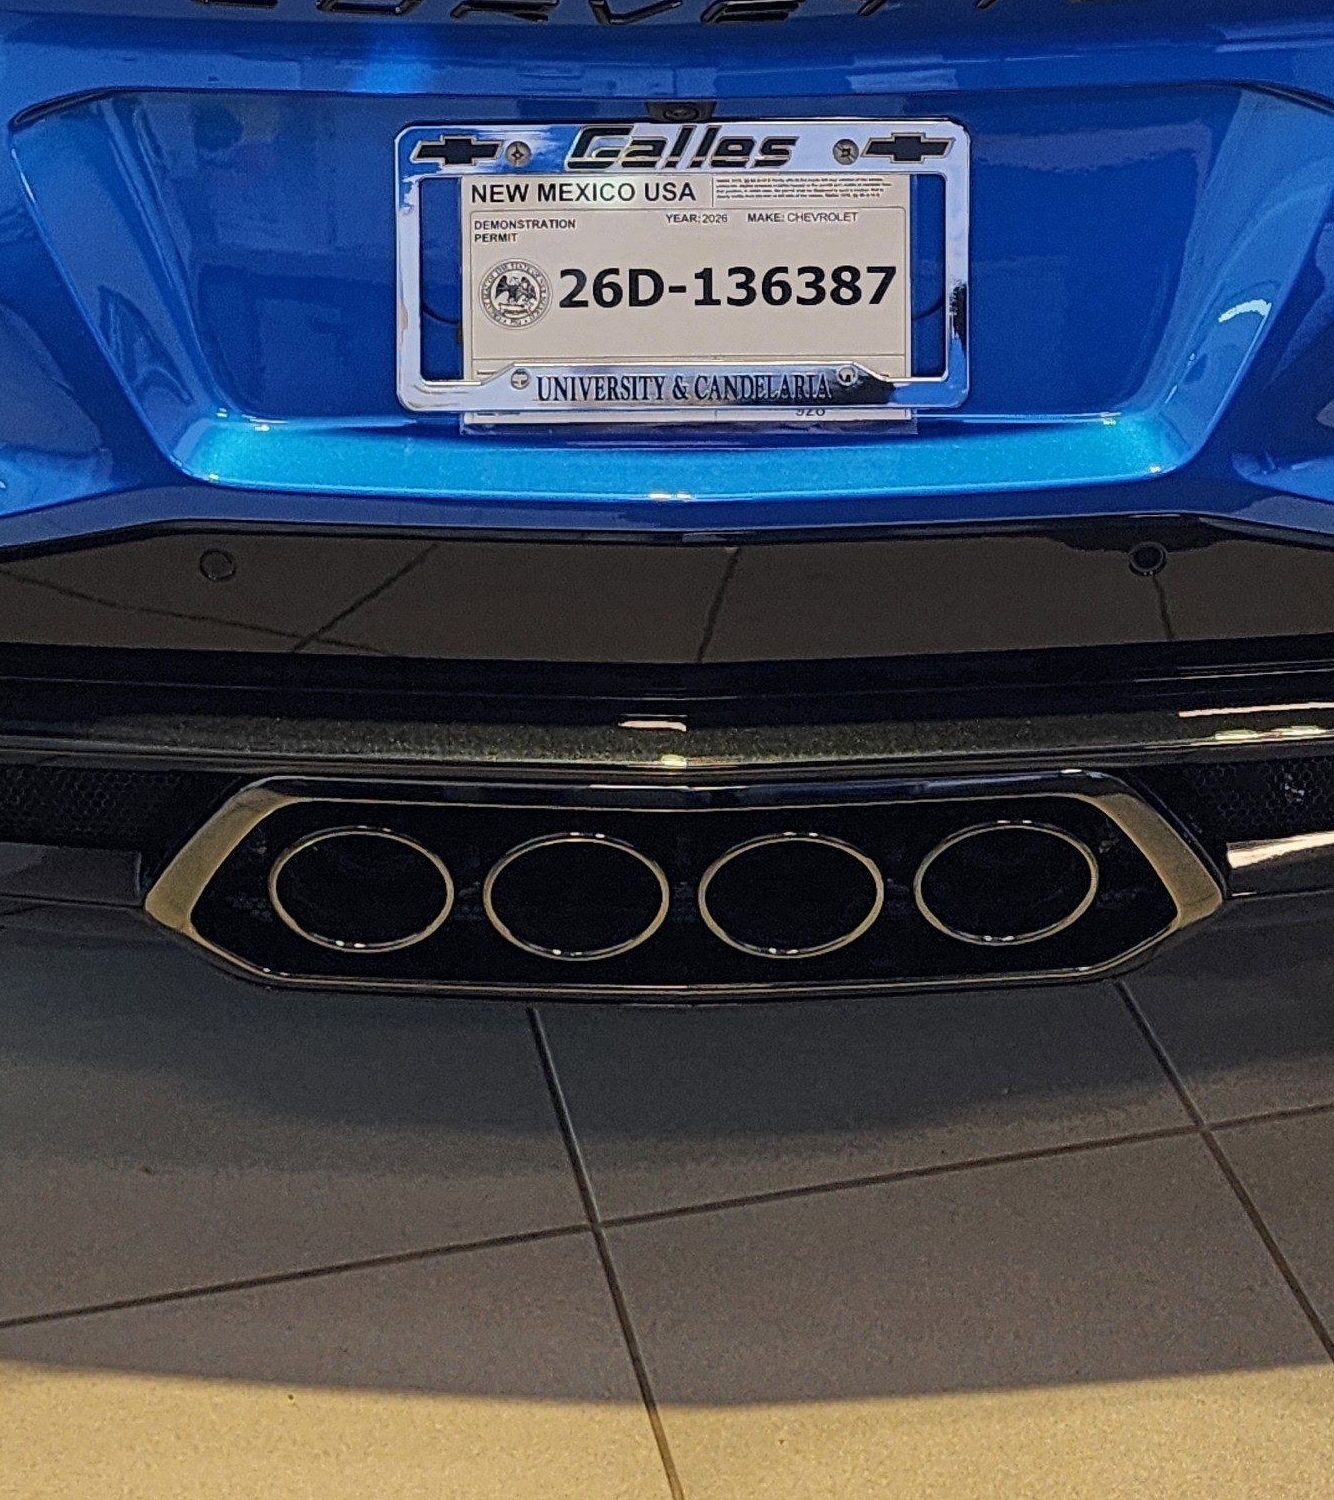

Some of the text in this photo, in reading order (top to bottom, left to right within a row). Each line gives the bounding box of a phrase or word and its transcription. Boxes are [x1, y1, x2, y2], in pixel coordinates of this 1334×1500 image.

[565, 125, 801, 171] Galles
[471, 183, 531, 204] NEW
[537, 182, 637, 203] MEXICO
[644, 182, 696, 202] USA
[474, 219, 576, 231] DEMONSTRATION
[666, 211, 858, 225] YEAR: 2026 MAKE: CHEVROLET
[474, 232, 518, 244] PERMIT
[558, 264, 898, 309] 26D-136387
[537, 371, 835, 402] UNIVERSITY & CANDELARIA
